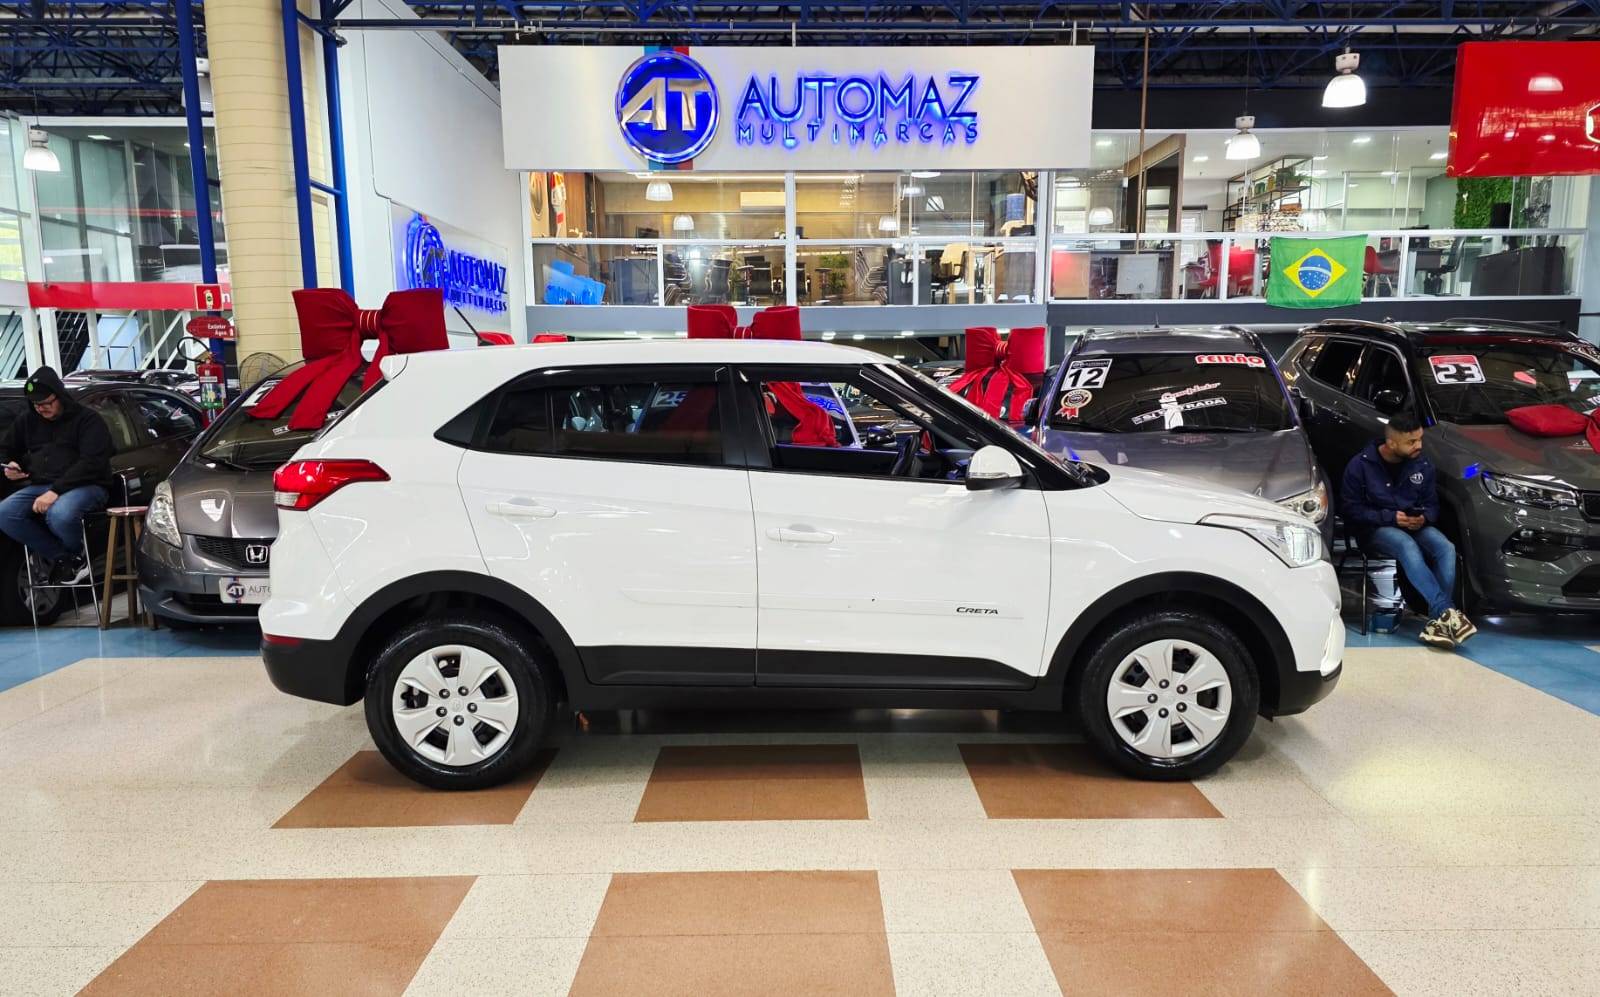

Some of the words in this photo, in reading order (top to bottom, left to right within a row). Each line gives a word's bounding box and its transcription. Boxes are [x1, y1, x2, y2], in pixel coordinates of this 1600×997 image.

[737, 75, 980, 121] AUTOMAZ
[737, 122, 979, 145] MULTIMARCAS
[446, 249, 508, 295] AUTOMAZ
[1196, 353, 1263, 364] FEIRÃO
[1069, 367, 1104, 388] 12
[1437, 364, 1482, 382] 23
[956, 606, 999, 615] CRETA
